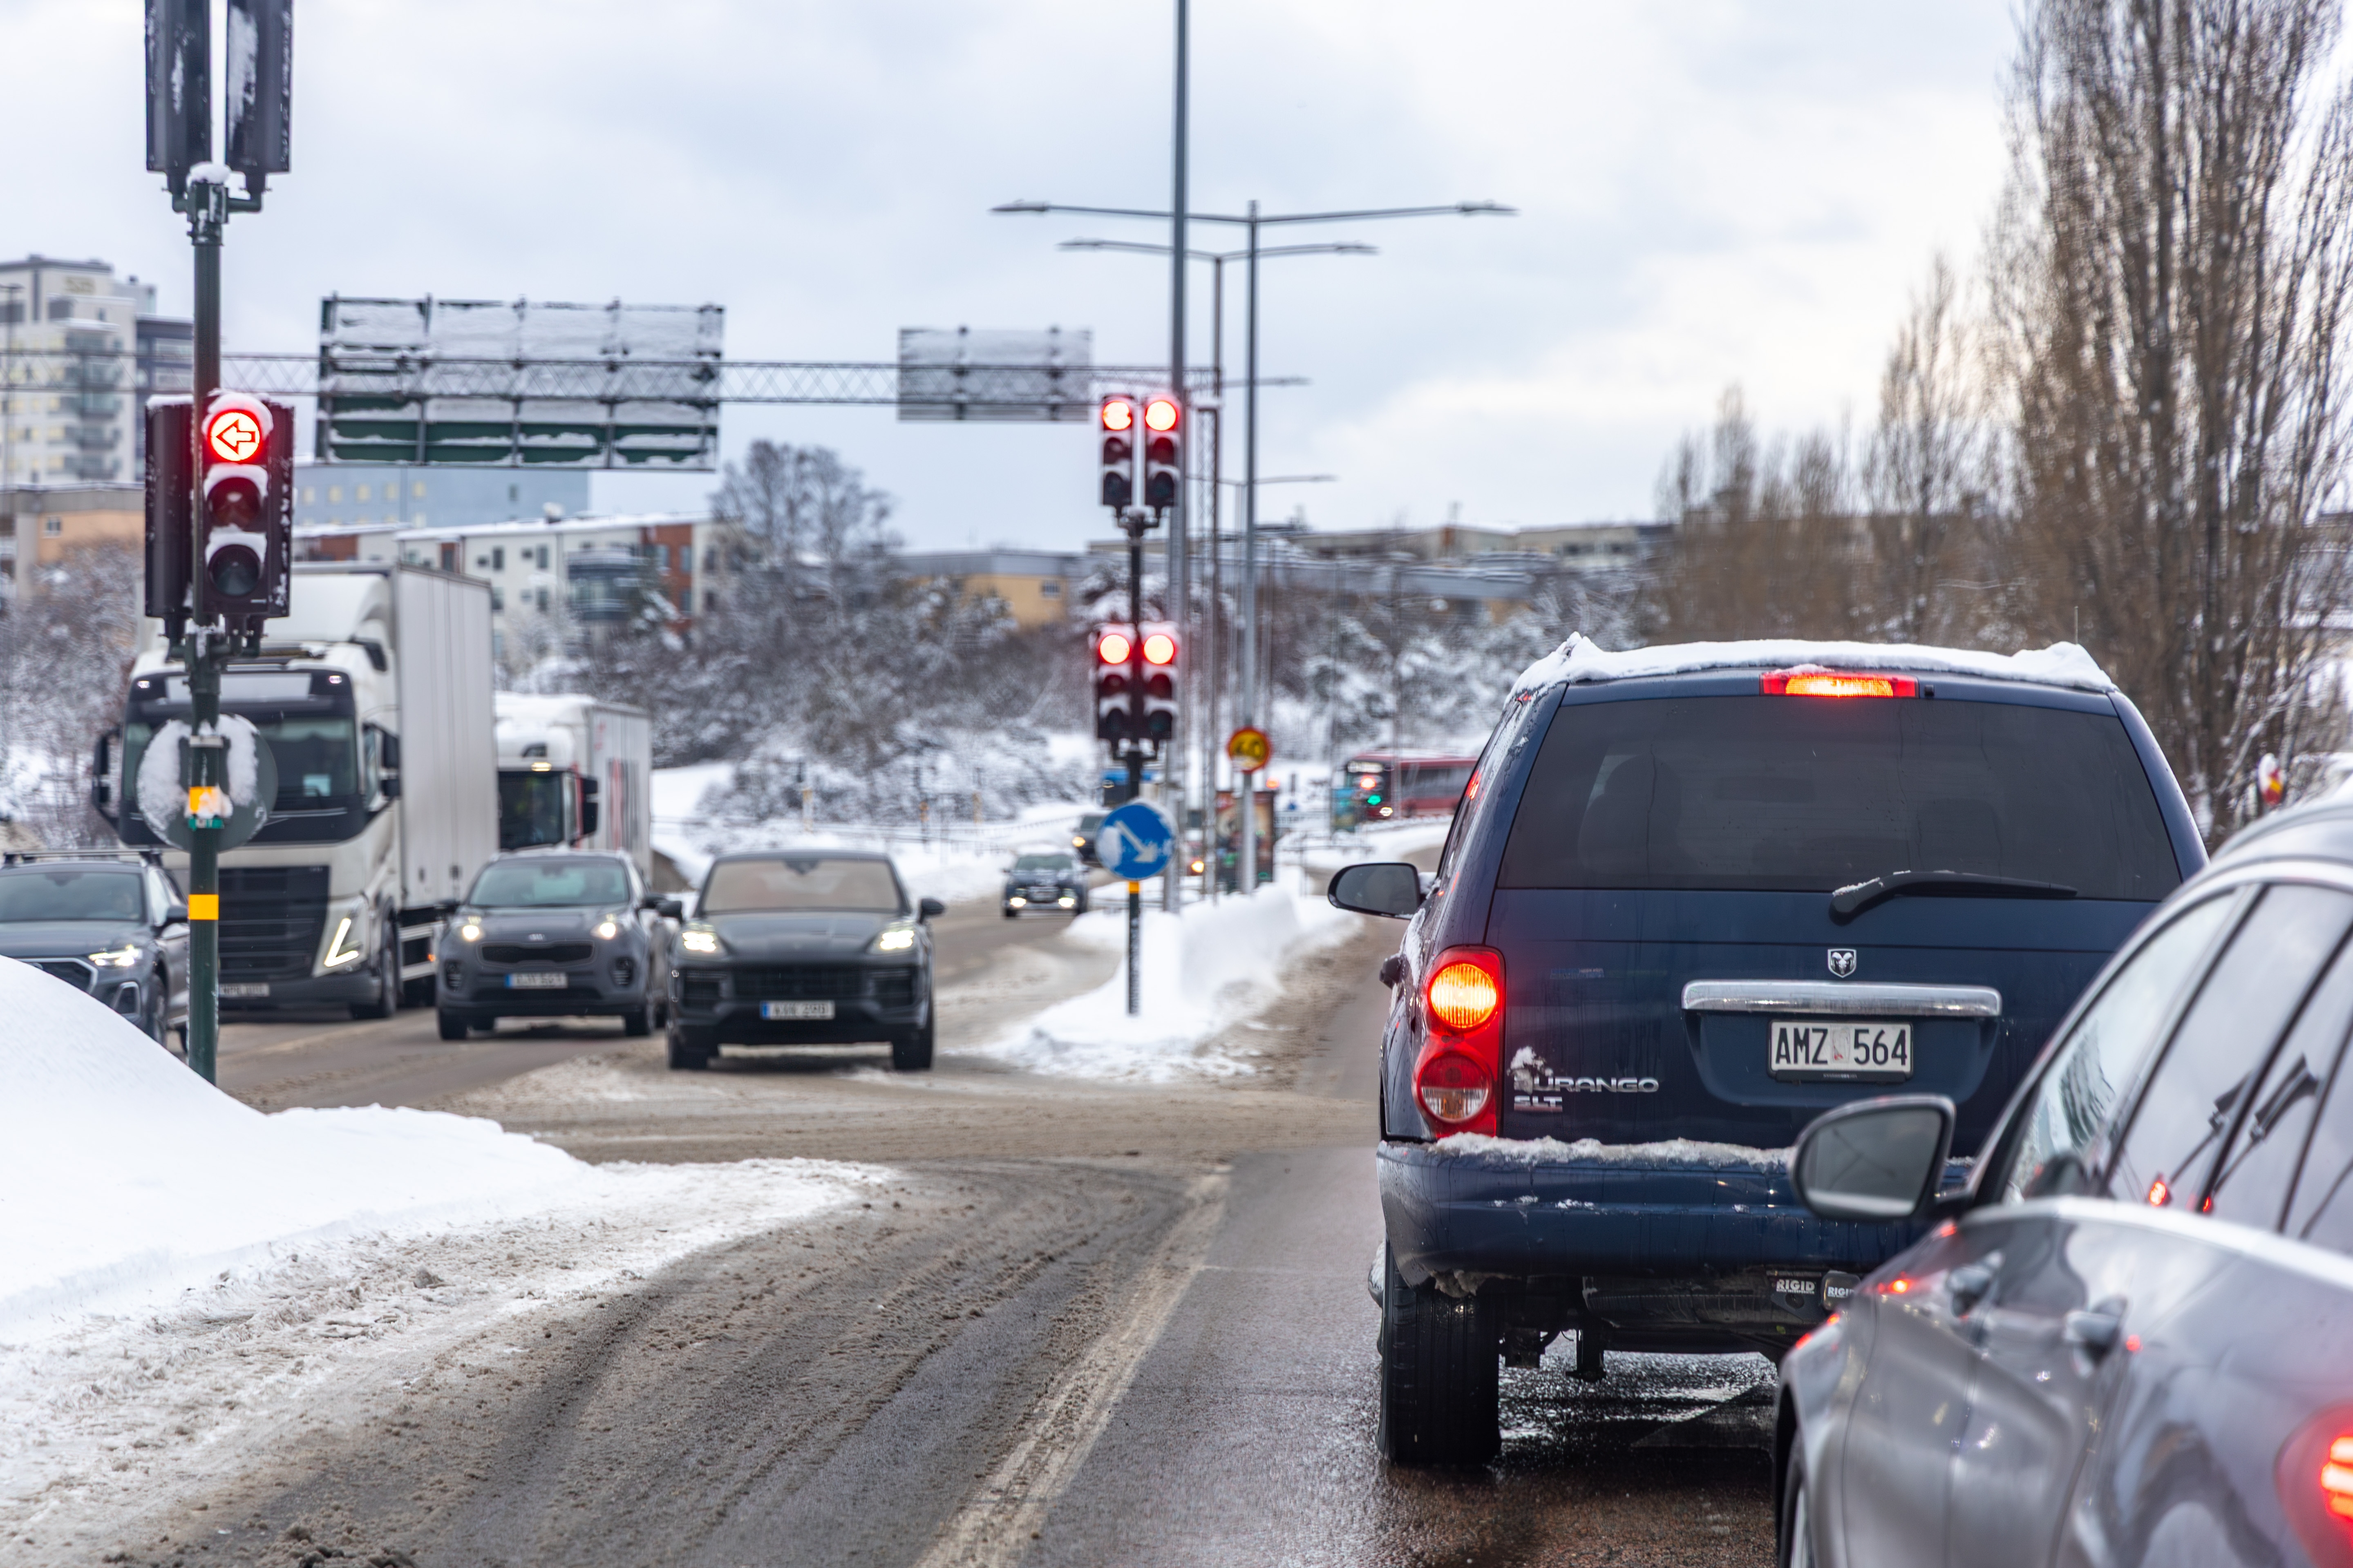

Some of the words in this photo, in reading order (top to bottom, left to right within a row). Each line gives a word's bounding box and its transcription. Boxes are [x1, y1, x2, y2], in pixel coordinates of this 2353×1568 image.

[1775, 1027, 1828, 1065] AMZ
[1853, 1028, 1908, 1066] 564
[1514, 1077, 1659, 1092] URANGO
[1514, 1095, 1563, 1108] SLT
[1776, 1279, 1815, 1291] RIGID
